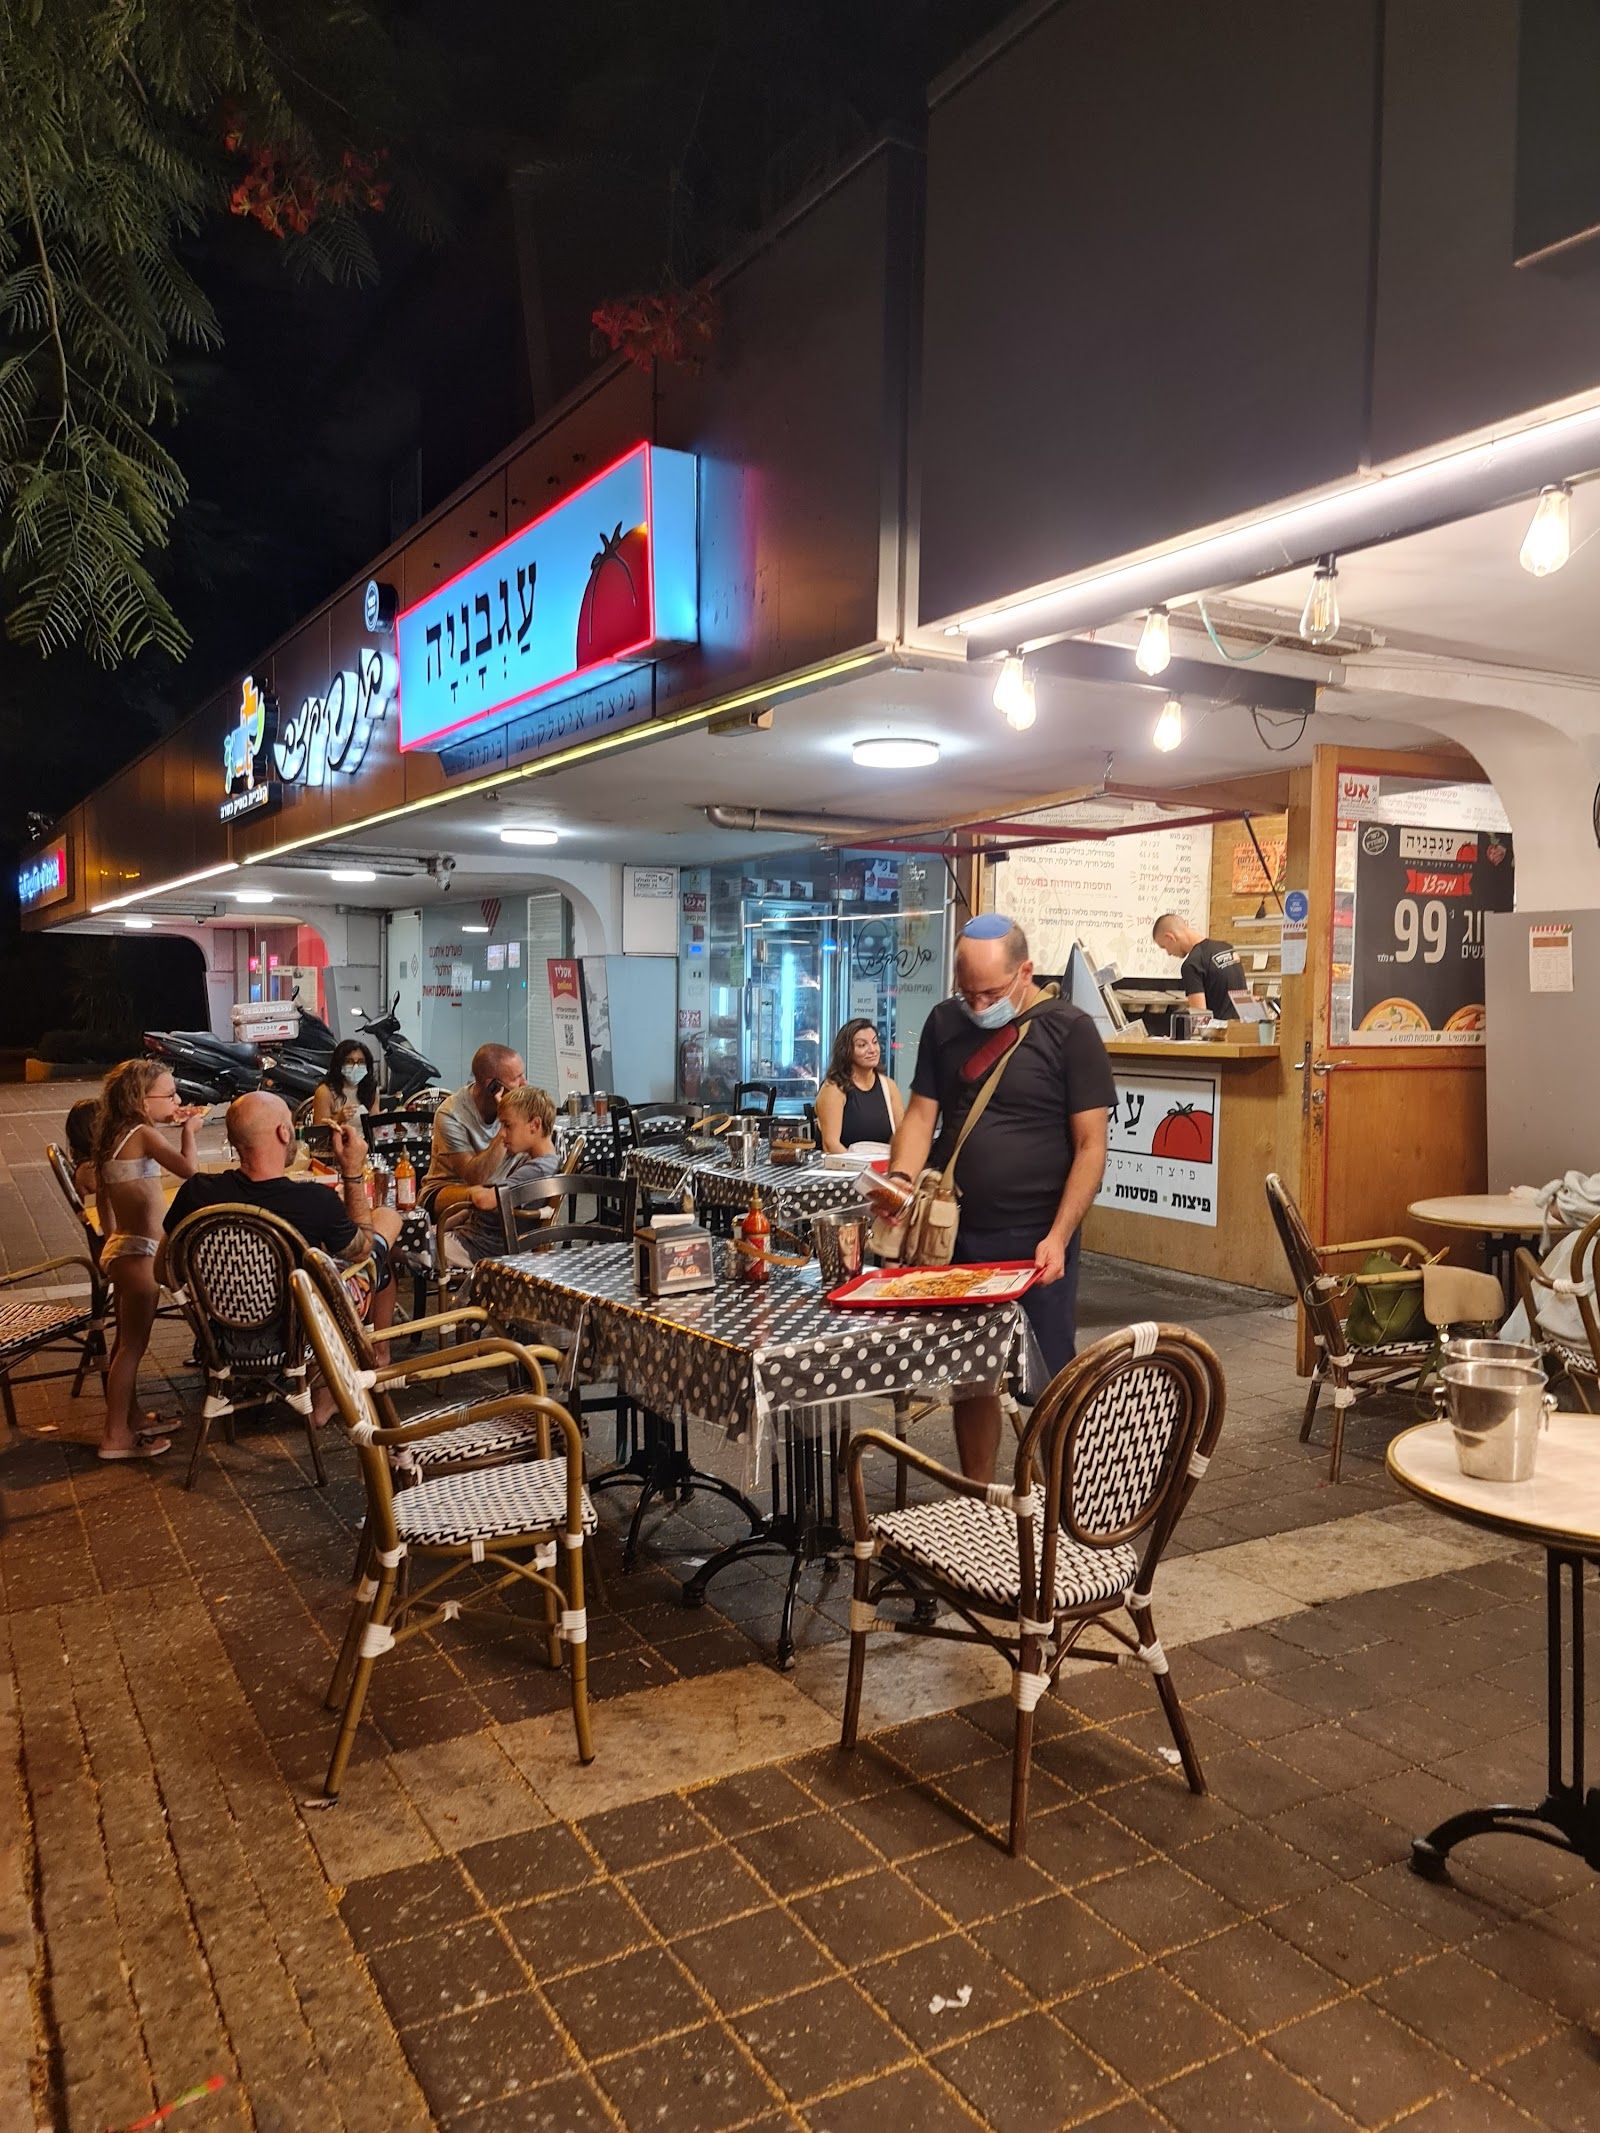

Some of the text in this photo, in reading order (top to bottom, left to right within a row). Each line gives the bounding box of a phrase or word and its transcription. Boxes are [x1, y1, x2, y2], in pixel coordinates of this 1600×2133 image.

[595, 688, 636, 722] פיצה
[520, 708, 585, 751] איטלקית
[1083, 881, 1112, 891] תוספות
[1422, 874, 1457, 895] מבצע
[1394, 898, 1448, 964] 99
[1156, 1165, 1196, 1181] פיצה
[1115, 1184, 1212, 1213] פיצות פסטות
